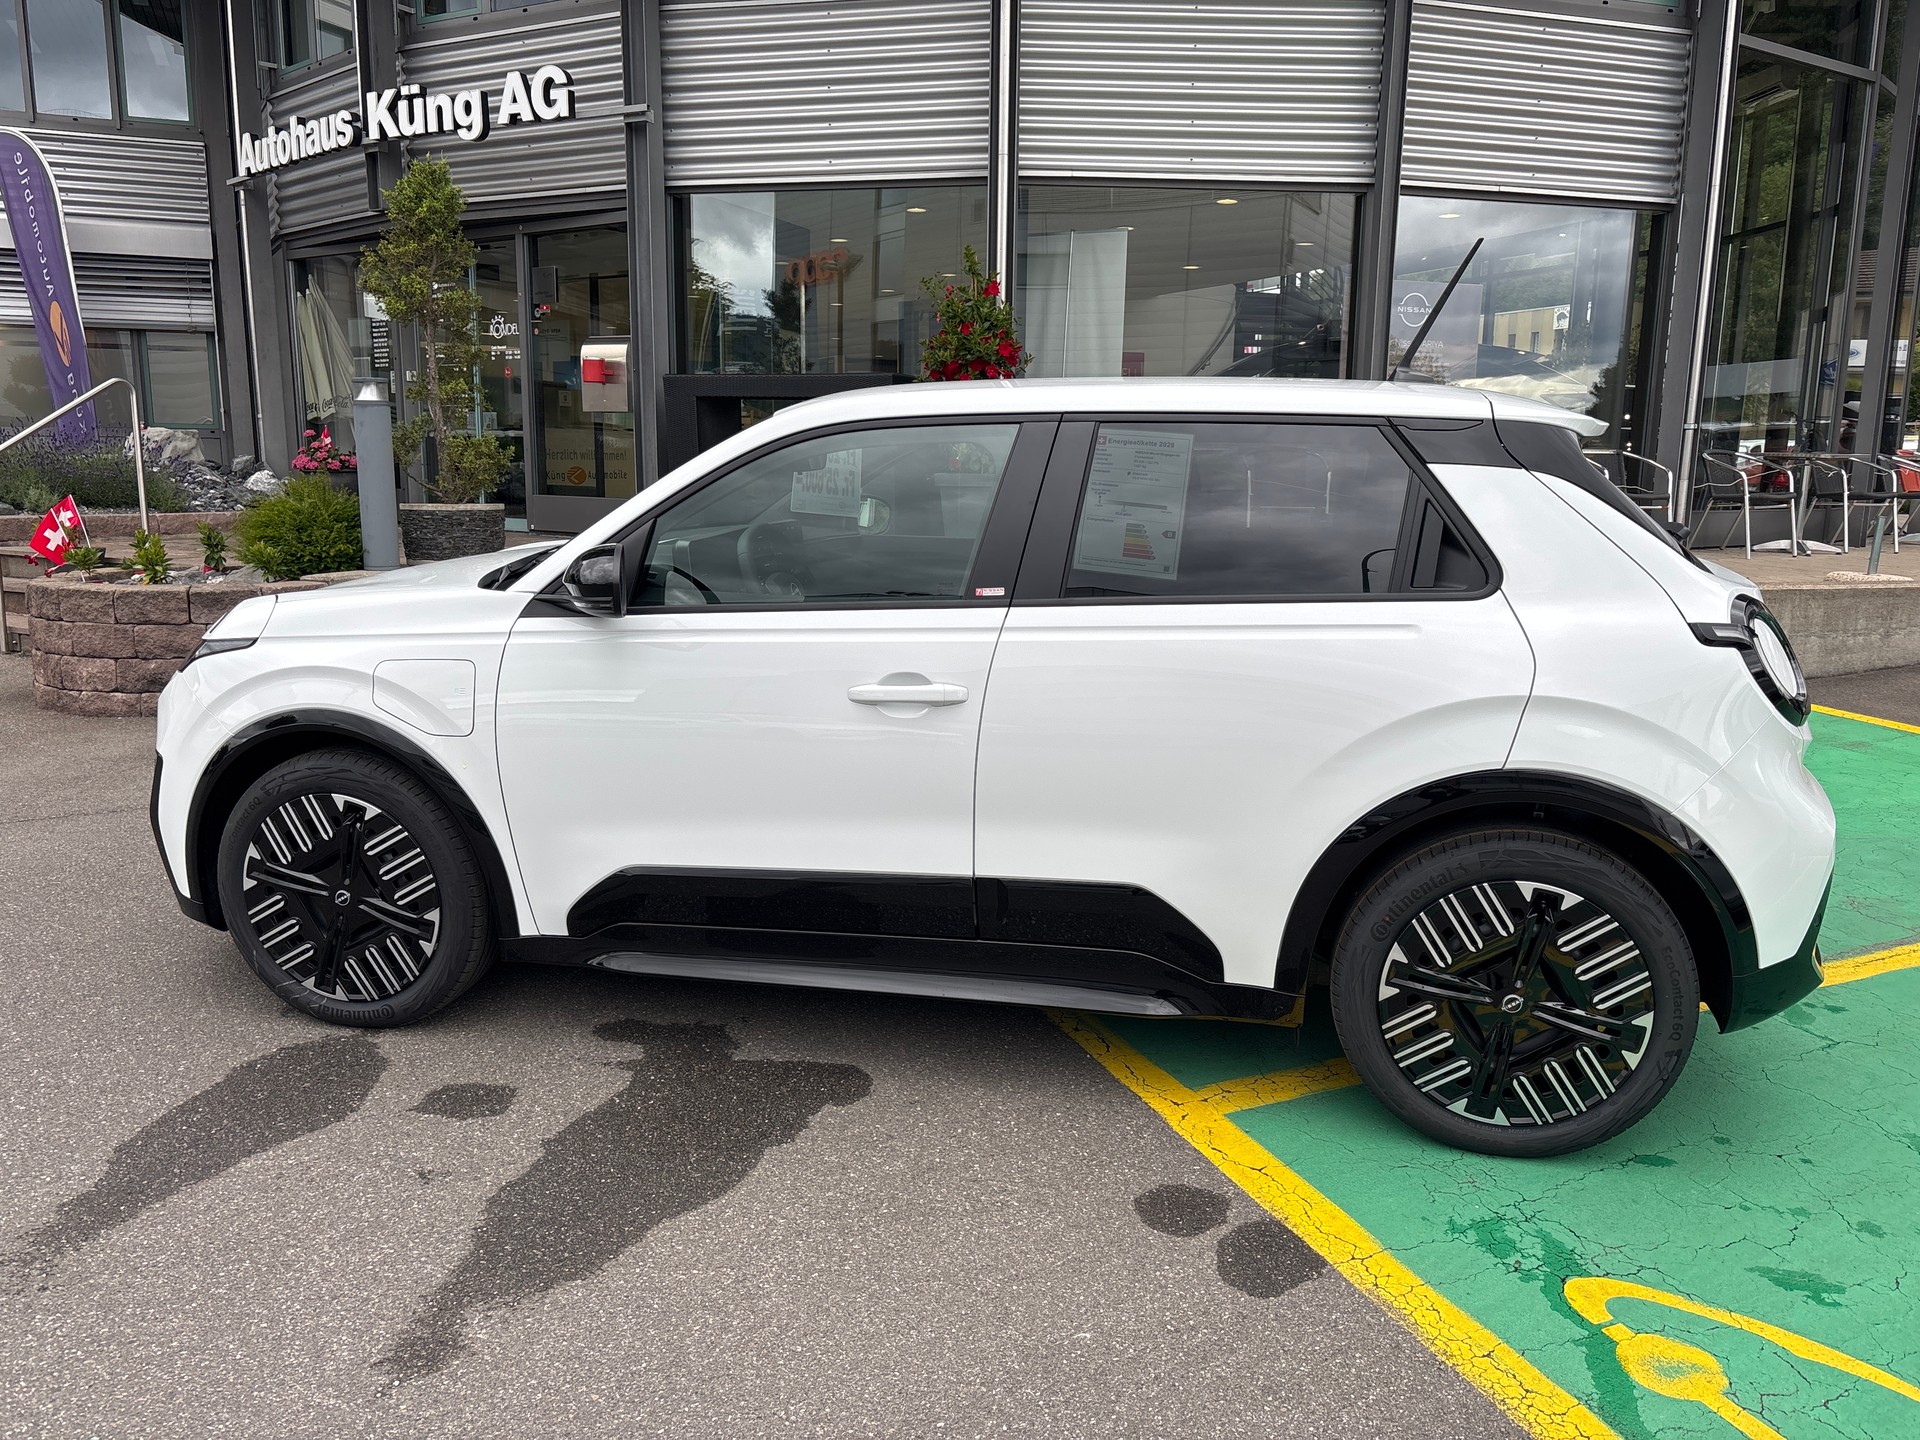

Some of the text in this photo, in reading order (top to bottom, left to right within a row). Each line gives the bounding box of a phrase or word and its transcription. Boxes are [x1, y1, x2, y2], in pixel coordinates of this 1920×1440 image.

[238, 64, 571, 176] Autohaus Küng AG
[546, 449, 627, 461] Herzlich willmmen!
[546, 470, 566, 481] Küng
[1370, 866, 1455, 942] Continental
